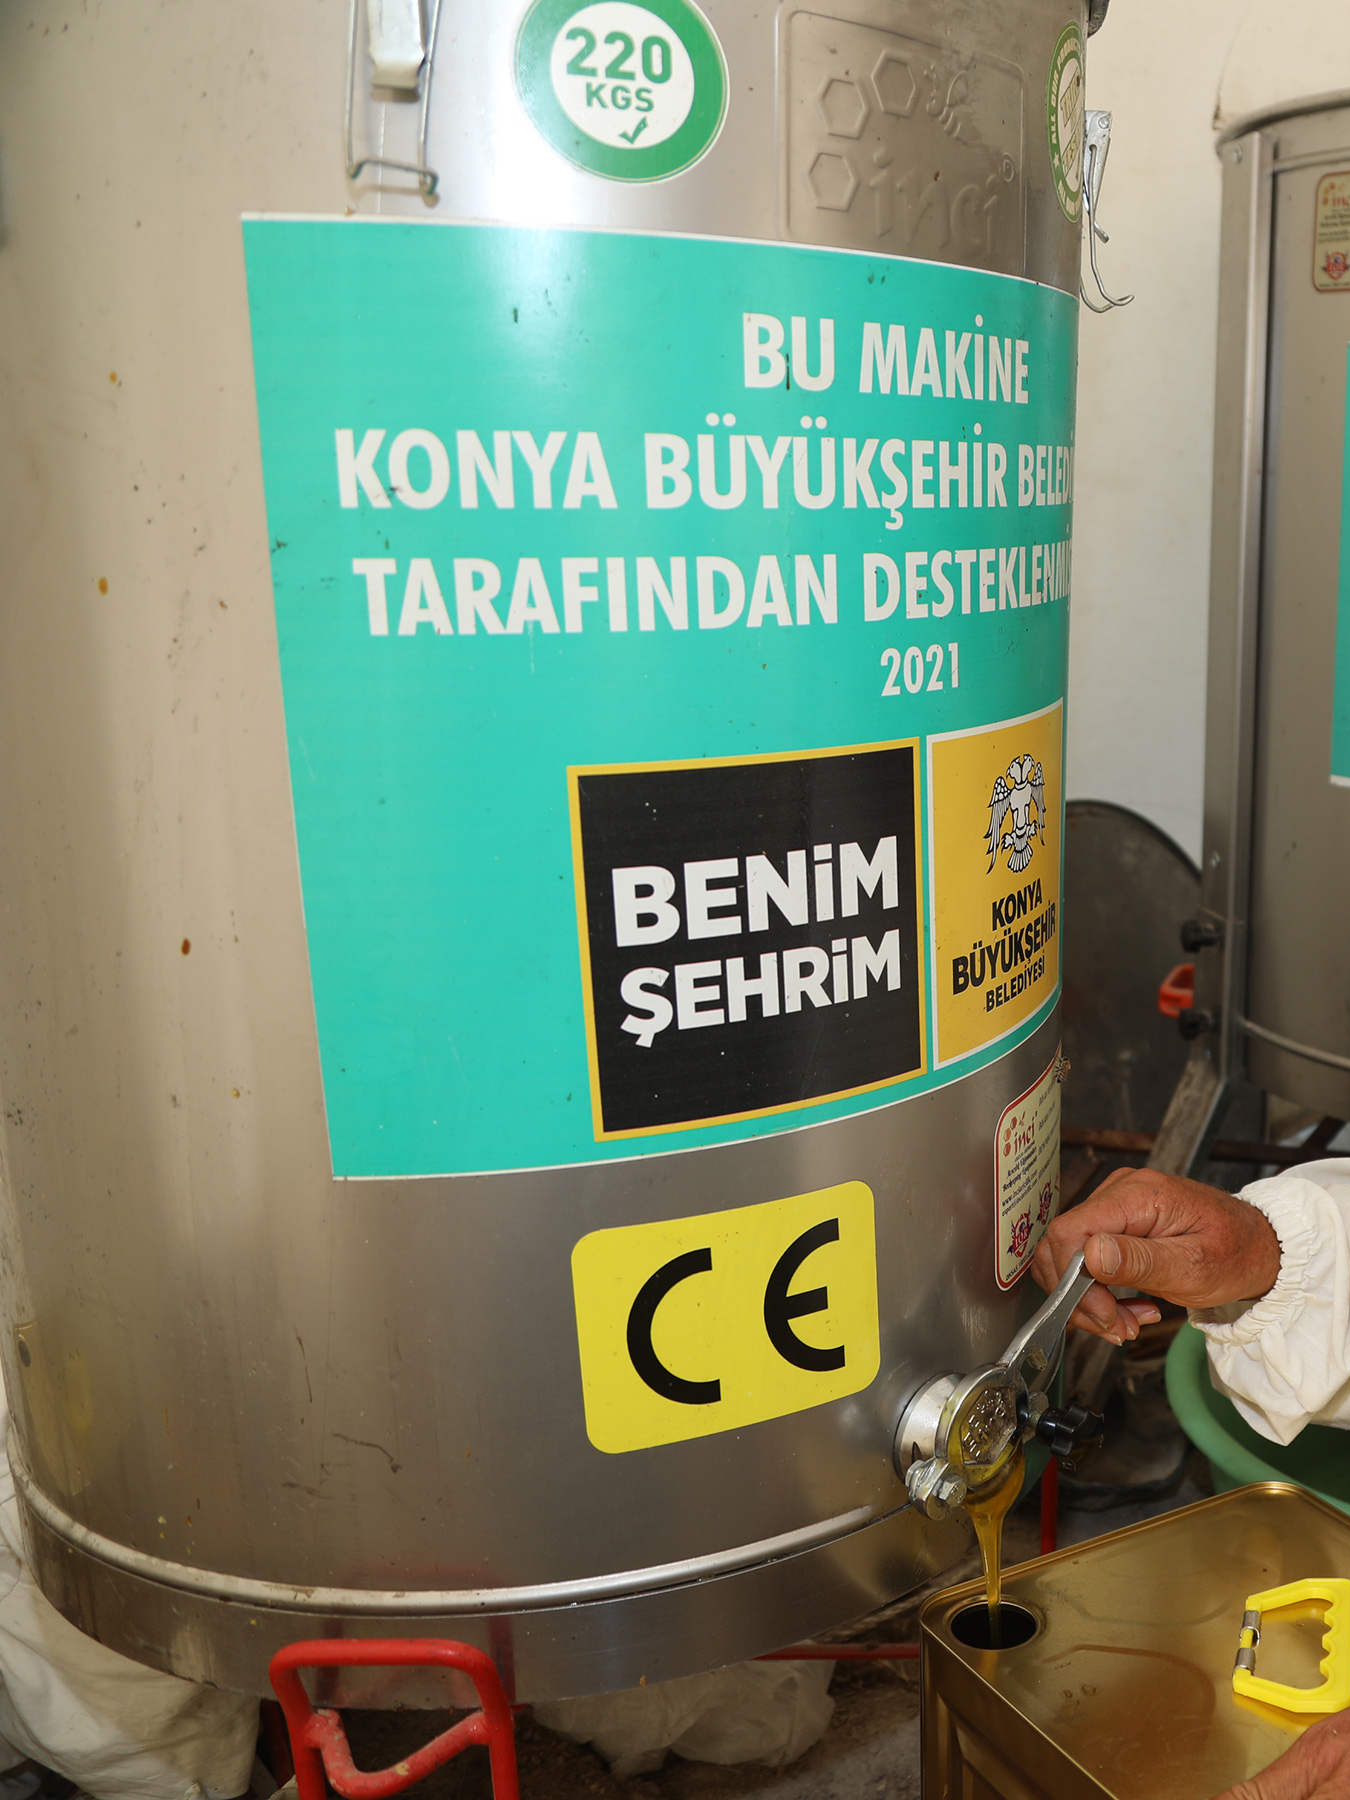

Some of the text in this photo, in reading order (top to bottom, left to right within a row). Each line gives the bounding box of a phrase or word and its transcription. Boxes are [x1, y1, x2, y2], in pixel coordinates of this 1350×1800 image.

[565, 26, 672, 84] 220
[585, 81, 655, 112] KGS
[743, 313, 1030, 404] BU MAKİNE
[335, 429, 618, 510] KONYA
[645, 413, 1008, 530] BÜYÜKŞEHİR
[352, 554, 838, 636] TARAFINDAN
[881, 643, 960, 697] 2021
[612, 836, 899, 948] BENİM
[992, 878, 1043, 932] KONYA
[620, 929, 900, 1048] ŞEHRİM
[952, 900, 1056, 996] BÜYÜKŞEHİR
[985, 949, 1046, 1013] BELEDİYESİ
[627, 1218, 846, 1405] CE
